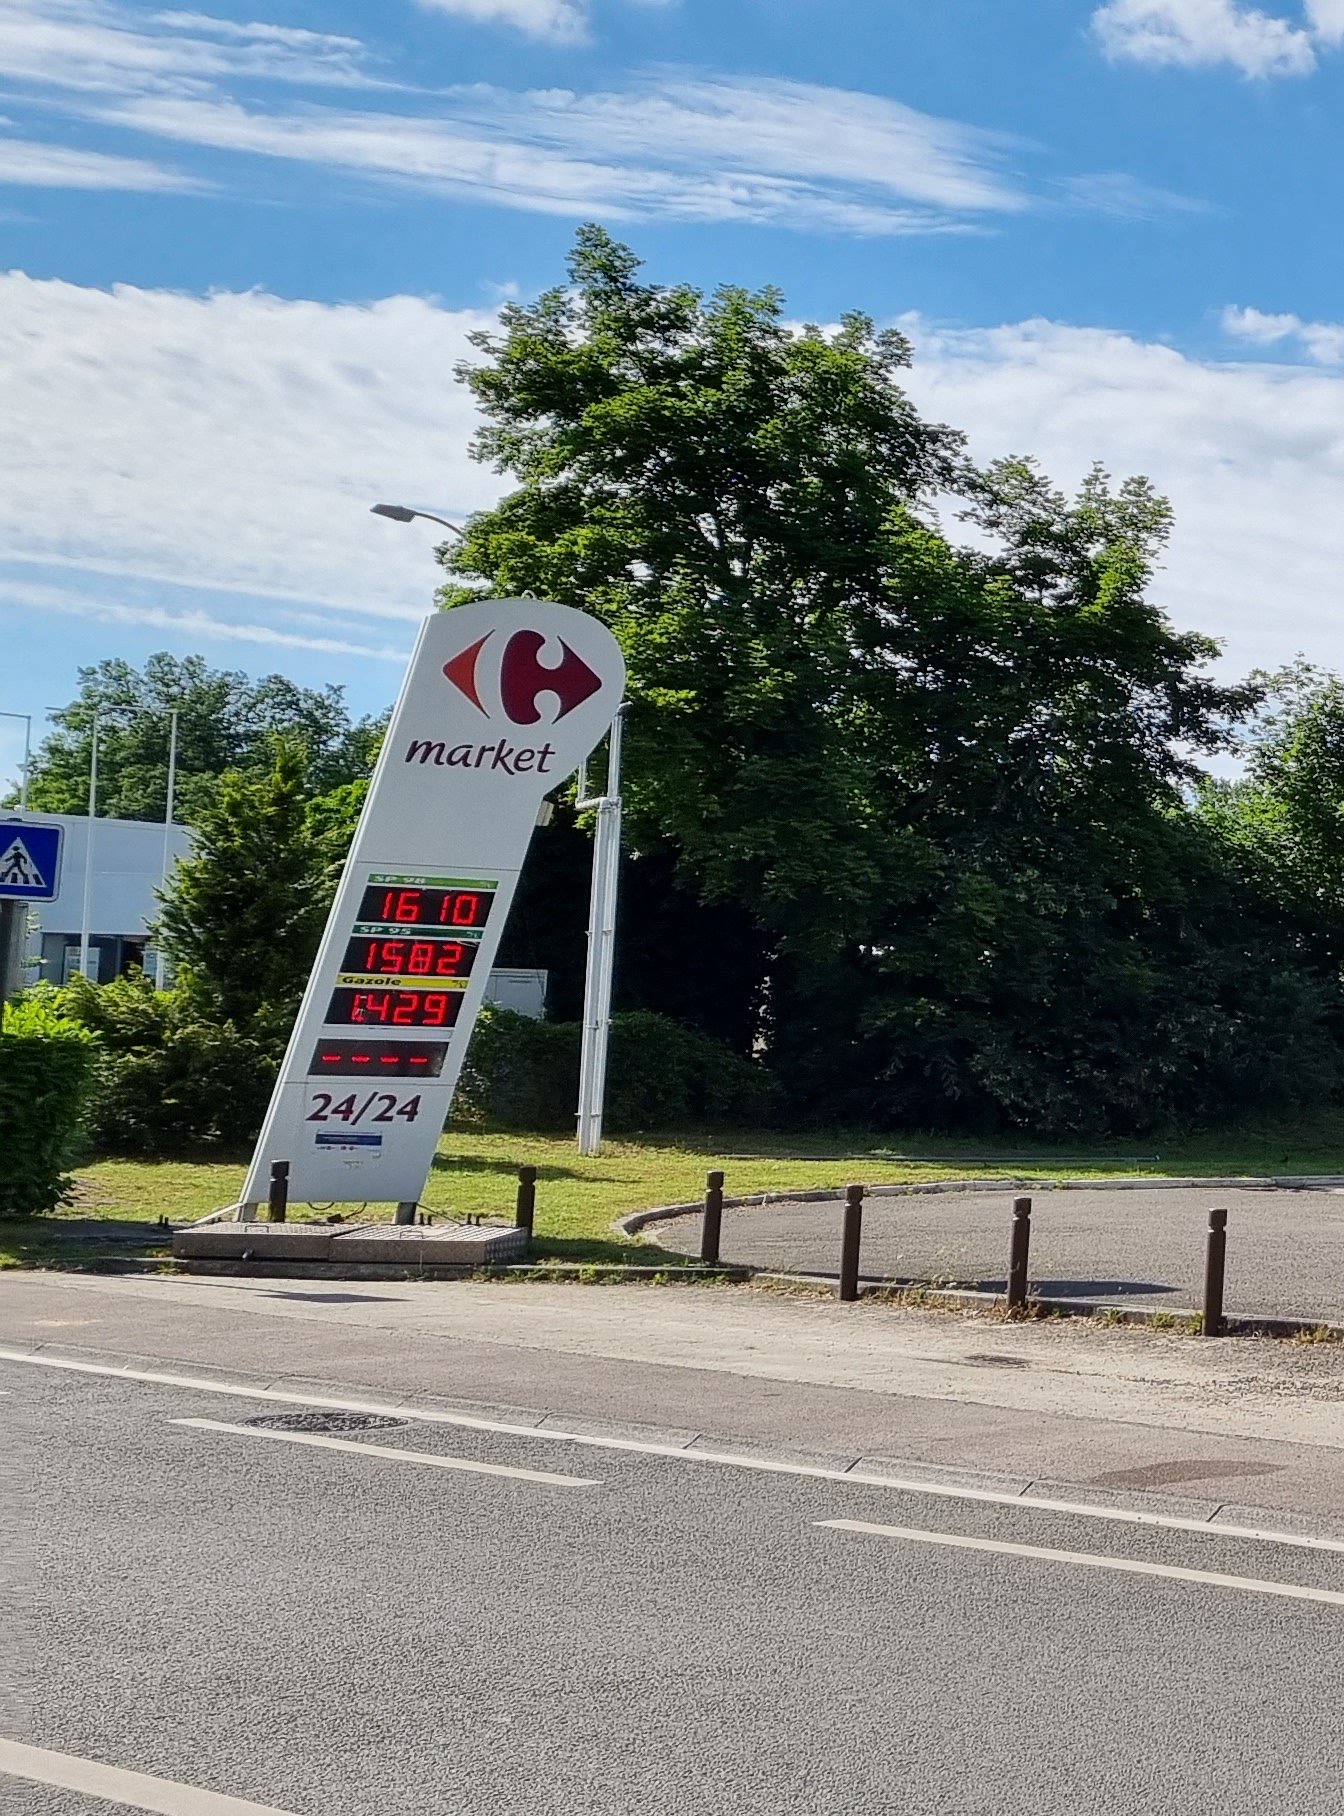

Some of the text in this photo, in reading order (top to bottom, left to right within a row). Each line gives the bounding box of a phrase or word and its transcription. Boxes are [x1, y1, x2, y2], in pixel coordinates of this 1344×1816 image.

[404, 738, 556, 776] market
[373, 875, 427, 885] SP 98
[360, 926, 411, 935] SP 95
[366, 942, 463, 974] 1582
[342, 976, 402, 986] Gazole
[305, 1091, 422, 1126] 24/24
